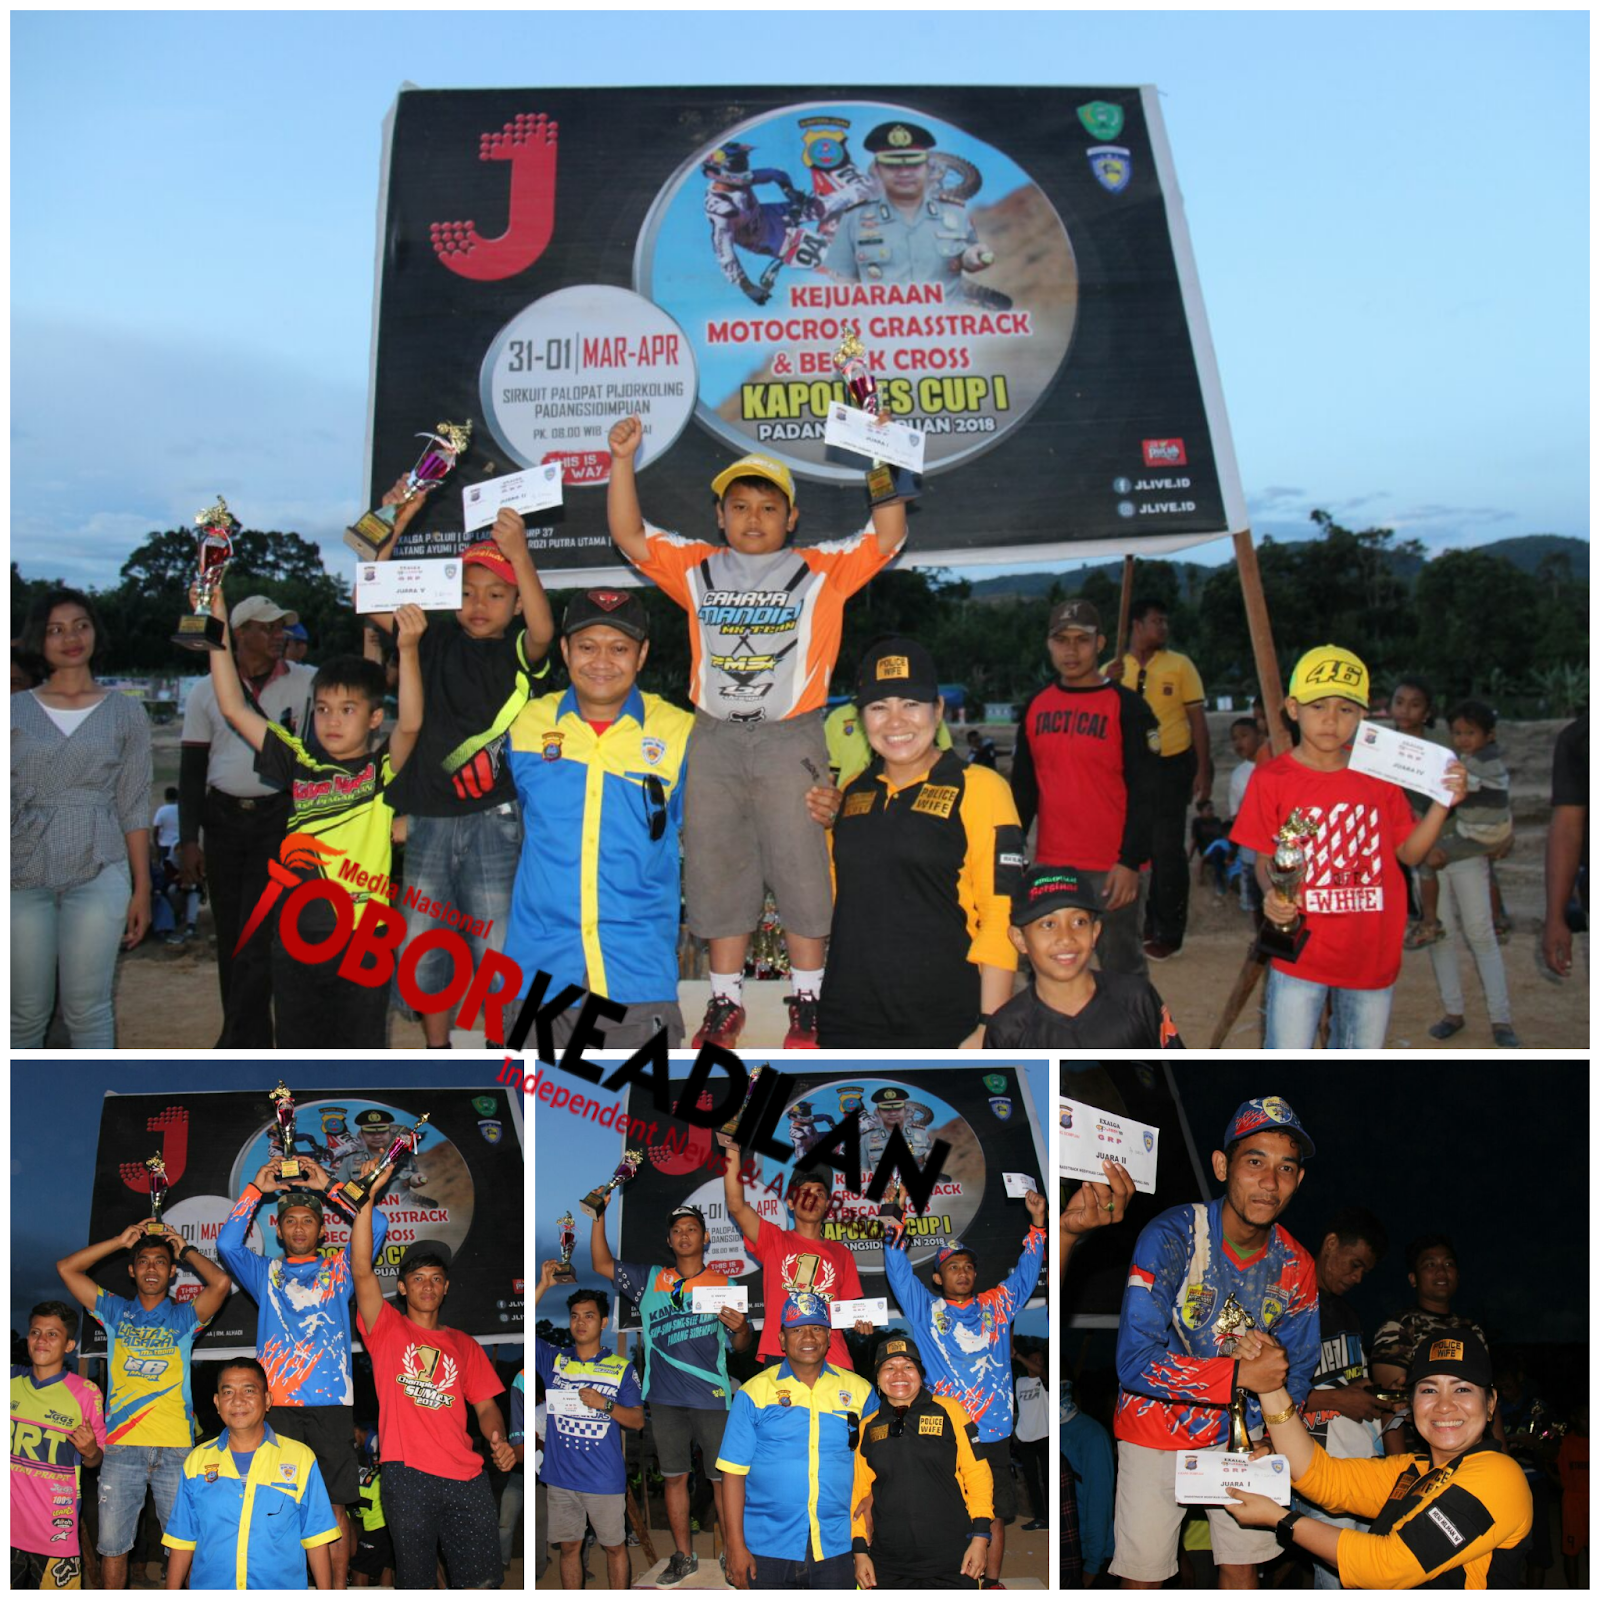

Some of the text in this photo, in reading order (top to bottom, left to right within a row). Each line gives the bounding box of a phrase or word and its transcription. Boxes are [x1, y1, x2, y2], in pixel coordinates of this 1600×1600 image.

[790, 283, 943, 308] KEJUARAAN
[707, 313, 1030, 344] MOTOCROSS GRASSTRACK
[508, 334, 679, 372] 31-01 MAR-APR
[799, 351, 887, 373] BECK
[893, 348, 971, 371] CROSS
[502, 382, 684, 404] SIRKUIT PALOPAT PIJORKOLING
[918, 377, 988, 415] CUP
[534, 400, 651, 419] PADANGSIDIMPUAN
[951, 417, 996, 433] 2018
[584, 453, 597, 466] IS
[1135, 477, 1191, 490] JLIVE.ID
[1139, 501, 1196, 514] JLIVE.ID
[548, 537, 576, 548] PUTRA
[577, 536, 606, 547] UTAMA
[878, 656, 906, 668] POLICE
[883, 665, 902, 676] WIFE
[1305, 659, 1363, 686] 46
[920, 785, 955, 801] POLICE
[916, 798, 950, 814] WIFE
[1095, 1151, 1120, 1163] JUARA
[907, 1216, 941, 1237] CUP
[385, 1229, 416, 1242] ROSS
[923, 1236, 945, 1246] 2018
[710, 1262, 727, 1270] THIS
[1434, 1341, 1461, 1350] POLICE
[1437, 1349, 1456, 1357] WIFE
[416, 1398, 441, 1408] 2017
[920, 1417, 943, 1426] POLICE
[920, 1425, 942, 1434] WIFE
